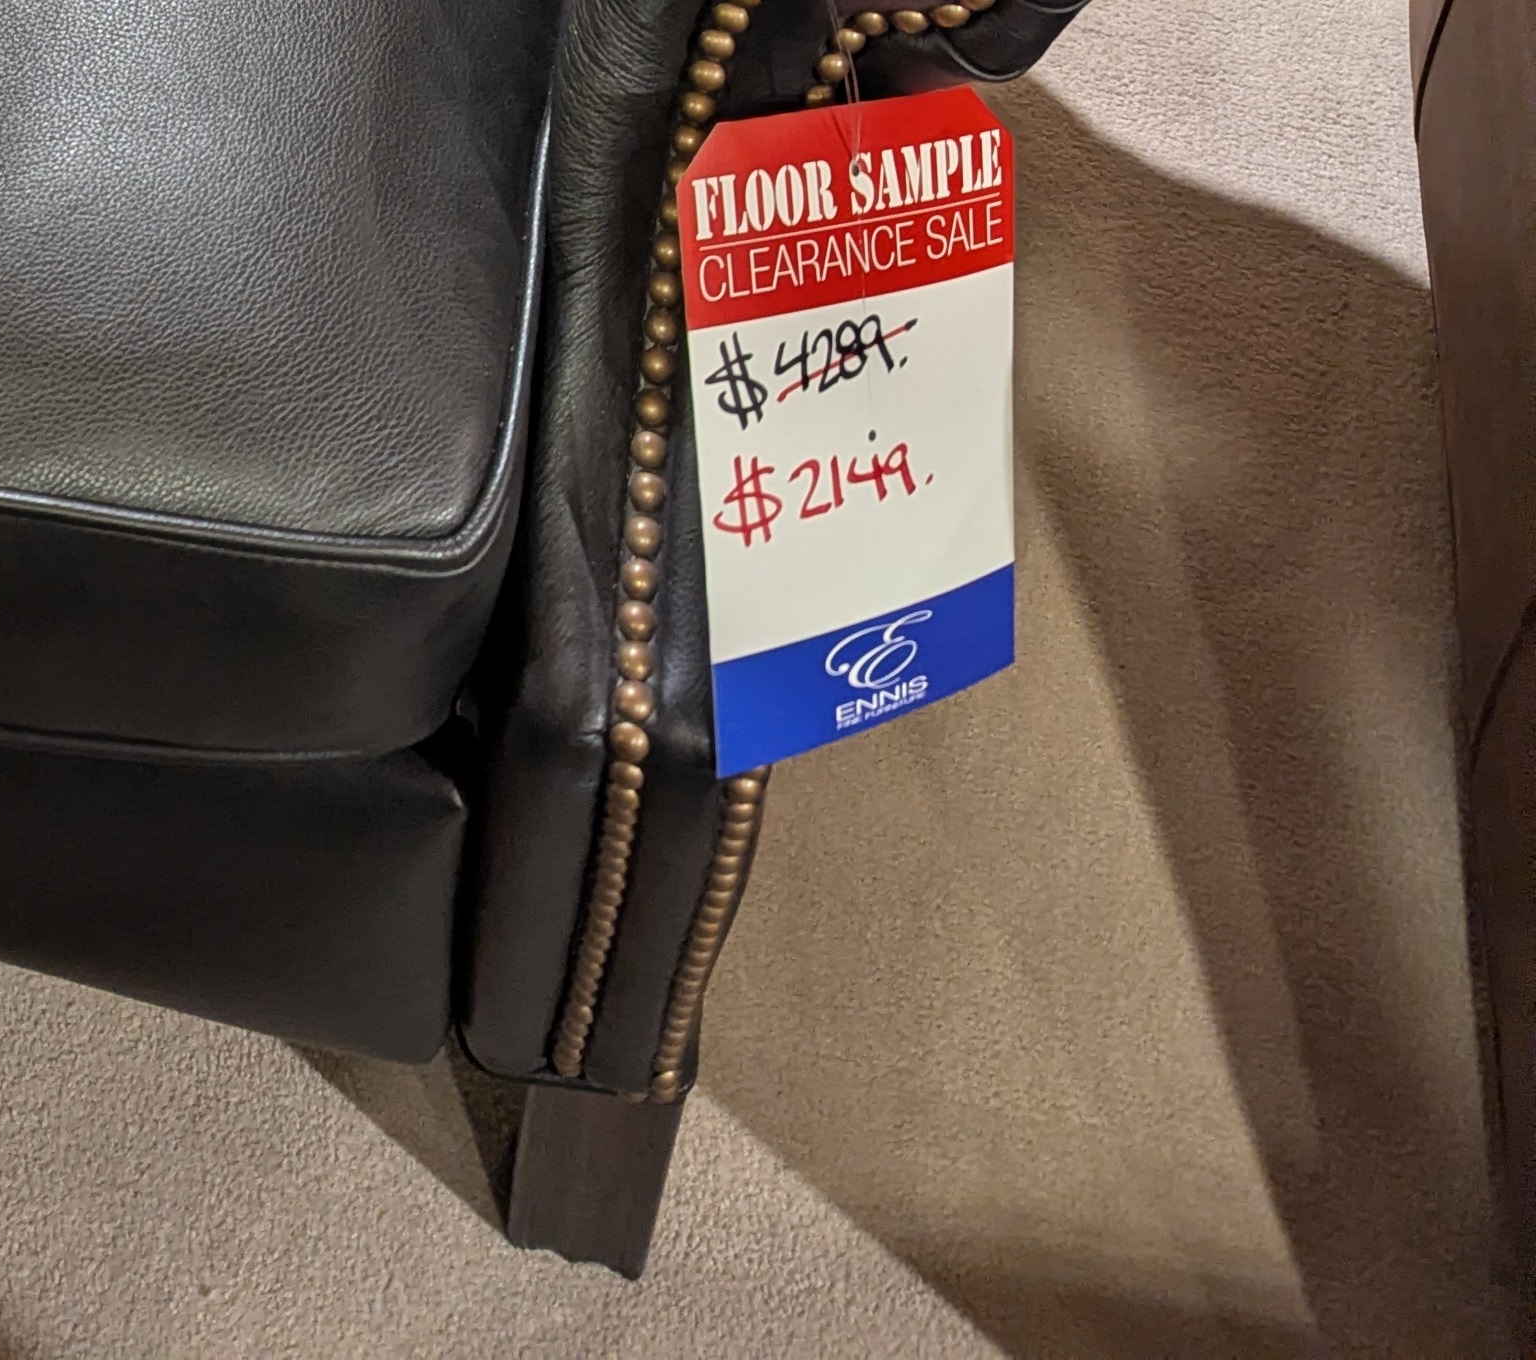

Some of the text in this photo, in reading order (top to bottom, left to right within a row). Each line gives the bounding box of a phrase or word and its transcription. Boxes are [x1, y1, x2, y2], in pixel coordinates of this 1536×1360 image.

[692, 129, 1002, 241] FLOOR SAMPLE
[699, 201, 1004, 303] CLEARANCE SALE
[836, 675, 928, 723] ENNIS
